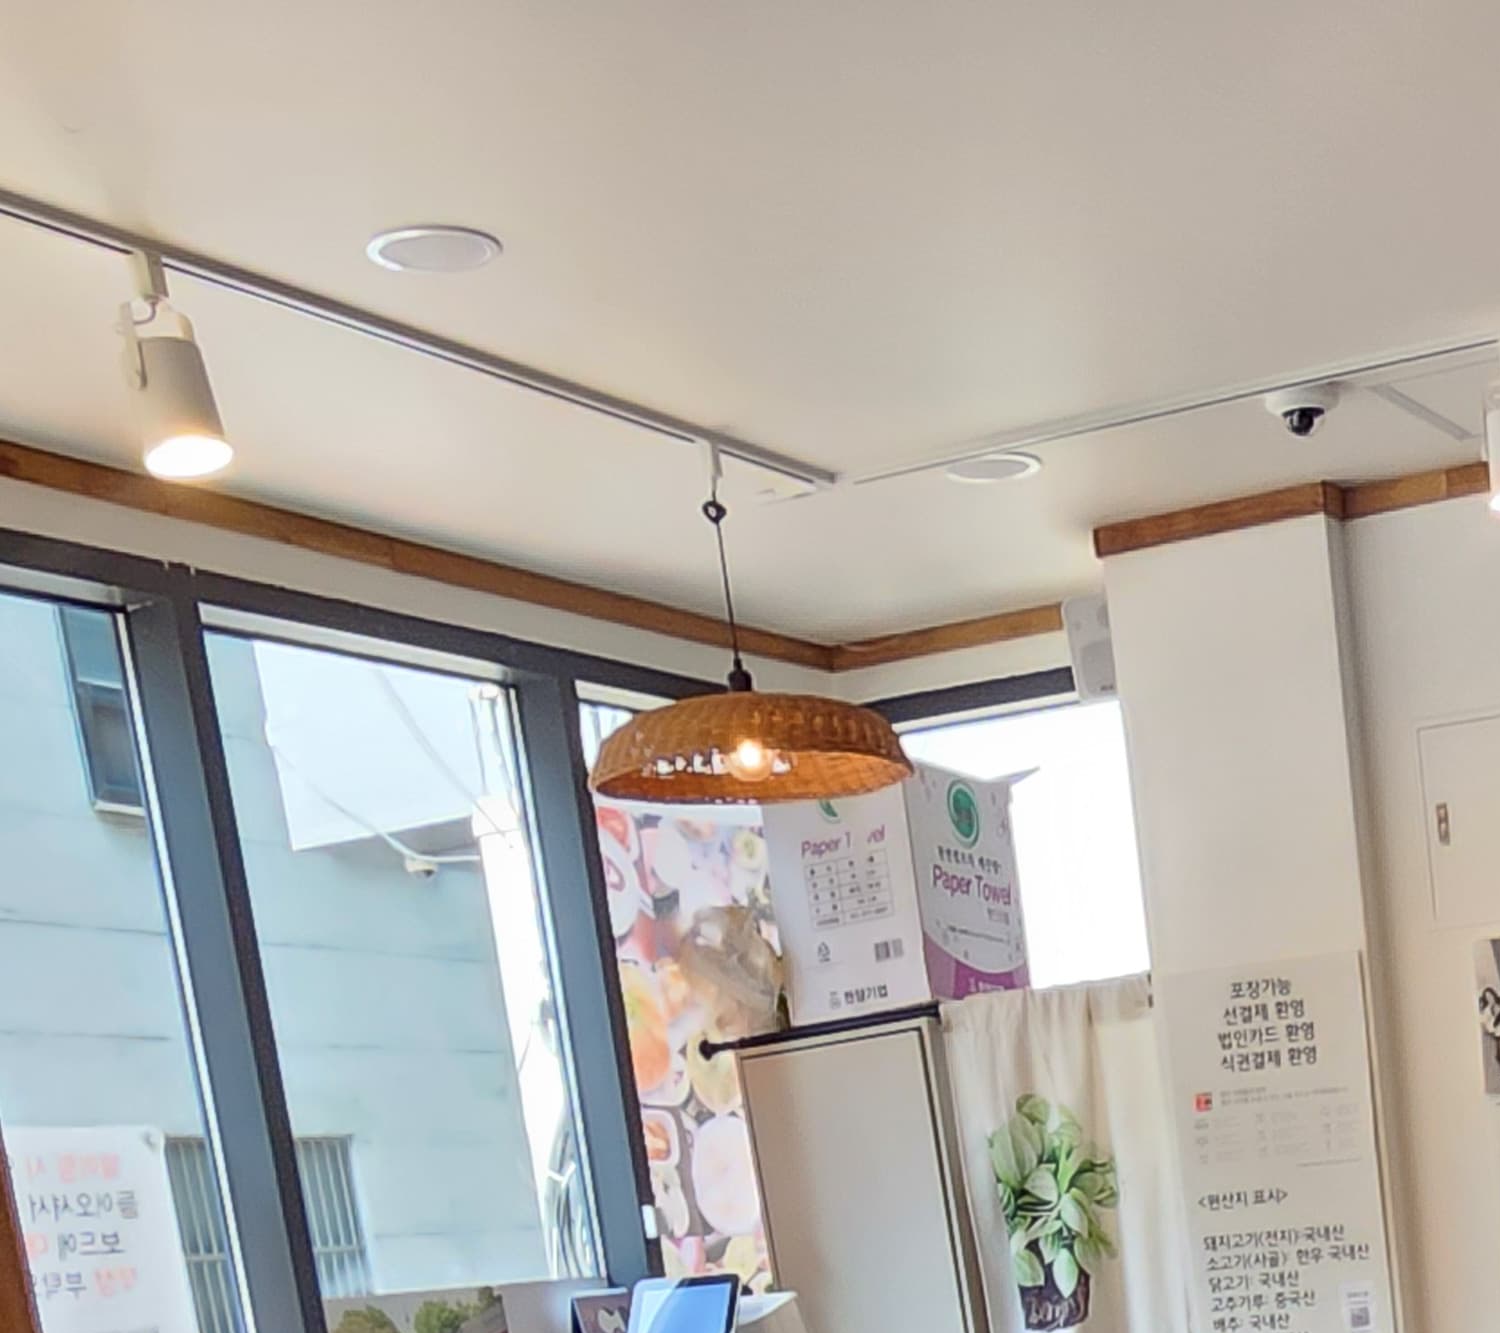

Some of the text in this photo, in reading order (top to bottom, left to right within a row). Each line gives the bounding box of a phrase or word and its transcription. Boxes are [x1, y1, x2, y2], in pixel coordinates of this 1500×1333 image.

[800, 837, 841, 860] Paper
[932, 863, 972, 897] Paper
[973, 874, 1012, 906] Towel
[1229, 977, 1292, 1000] 포장가능
[1222, 999, 1306, 1027] 선결제 환영
[1216, 1021, 1316, 1051] 법인카드 환영
[1219, 1045, 1319, 1074] 식권결제 환영
[1303, 1224, 1345, 1243] 국내산
[1296, 1248, 1323, 1266] 한우
[1327, 1243, 1370, 1261] 국내산
[1258, 1269, 1300, 1289] 국내산
[1274, 1289, 1316, 1308] 중국산
[1249, 1311, 1291, 1330] 국내산
